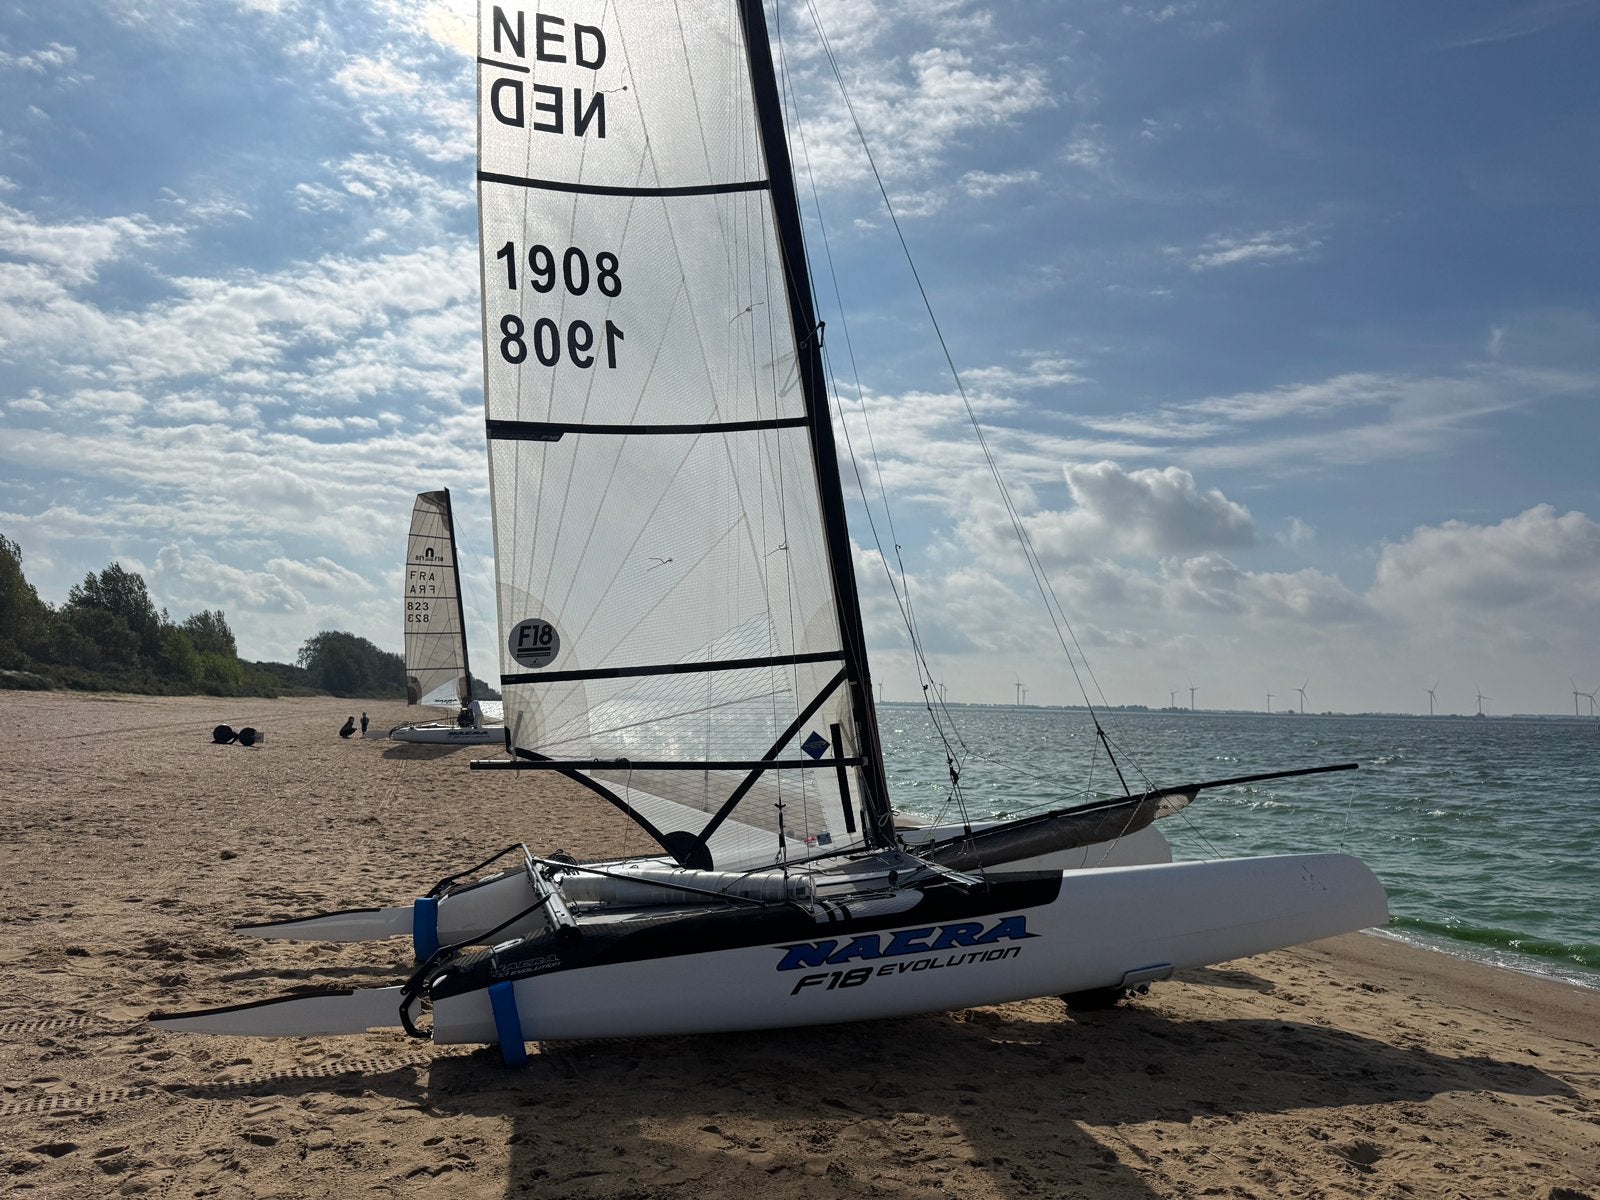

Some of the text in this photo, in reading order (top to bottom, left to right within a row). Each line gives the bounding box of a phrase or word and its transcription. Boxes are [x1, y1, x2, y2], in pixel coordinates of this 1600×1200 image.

[492, 5, 606, 71] NED
[496, 241, 622, 298] 1908
[410, 570, 435, 581] FRA
[407, 602, 429, 611] 823
[518, 624, 553, 647] F18
[771, 915, 1042, 972] NACRA
[790, 946, 1022, 996] F18 EVOLUTION
